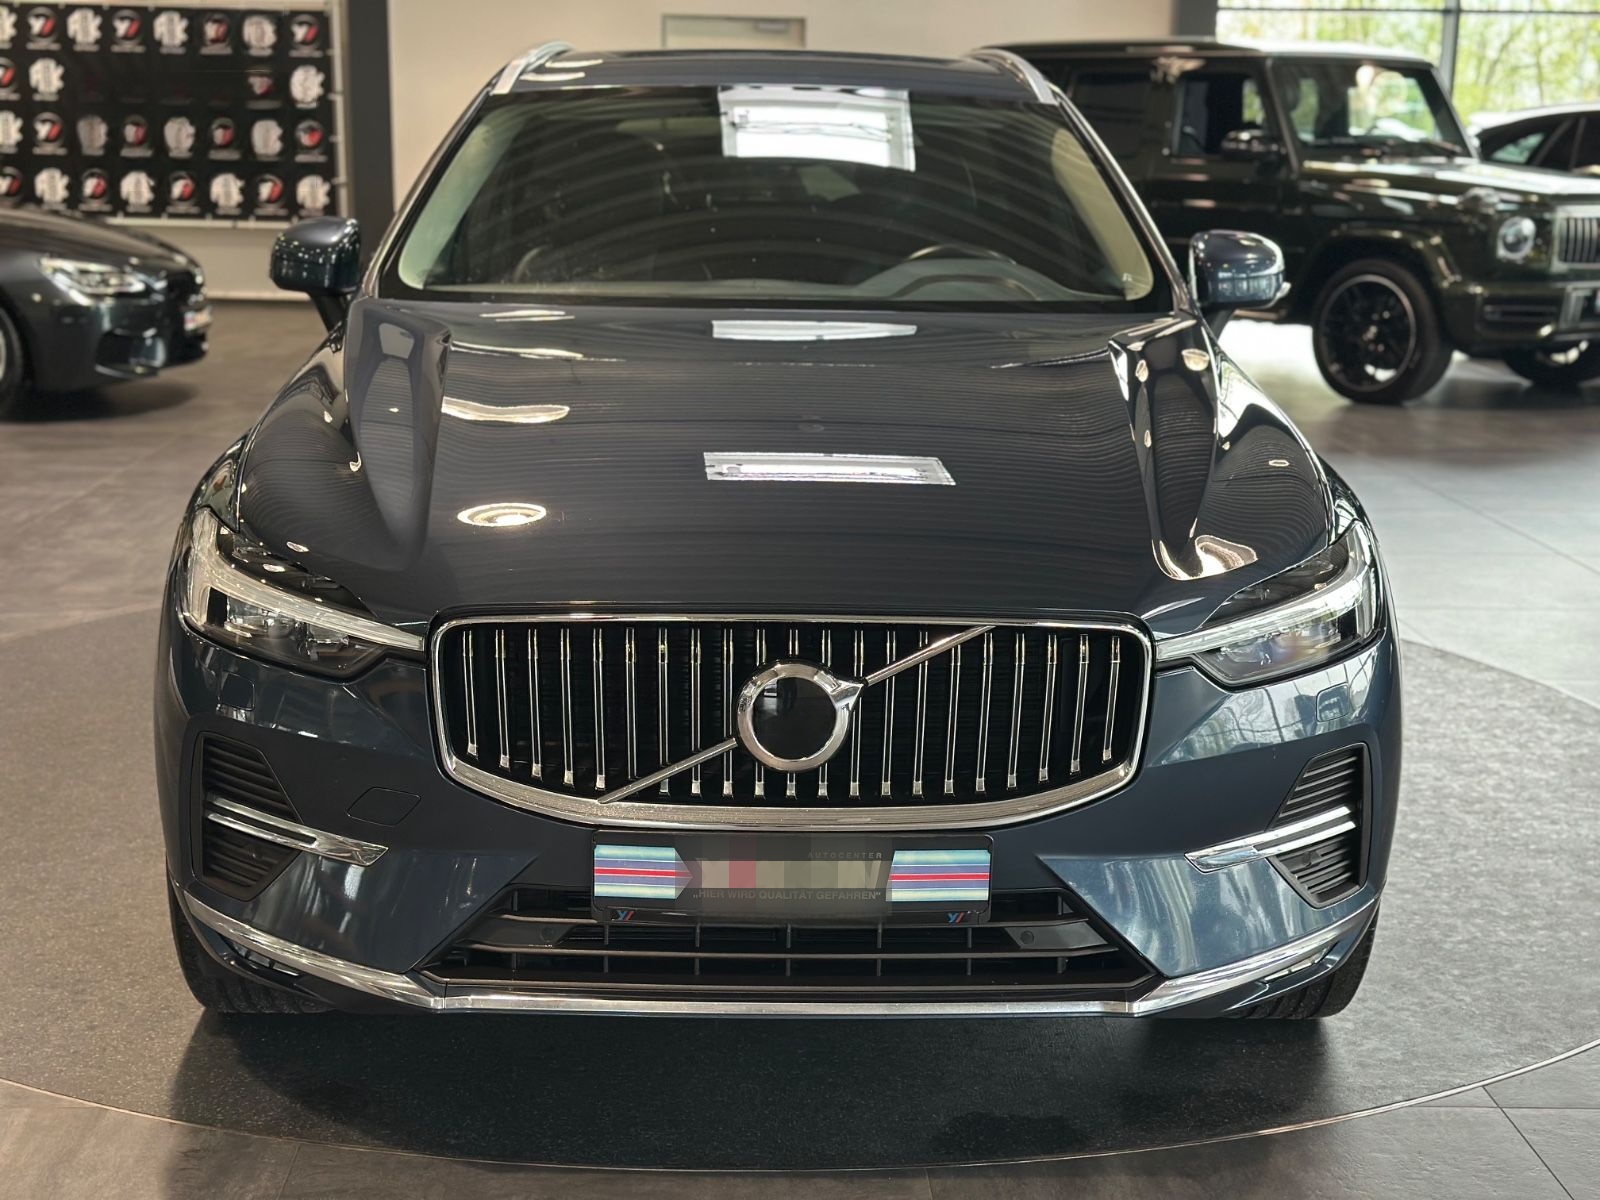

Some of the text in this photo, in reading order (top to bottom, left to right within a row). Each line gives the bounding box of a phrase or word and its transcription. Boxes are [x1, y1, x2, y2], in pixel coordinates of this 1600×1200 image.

[807, 851, 882, 859] AUTOCENTER
[727, 890, 756, 899] WIRD
[759, 890, 812, 900] QUALITÄT
